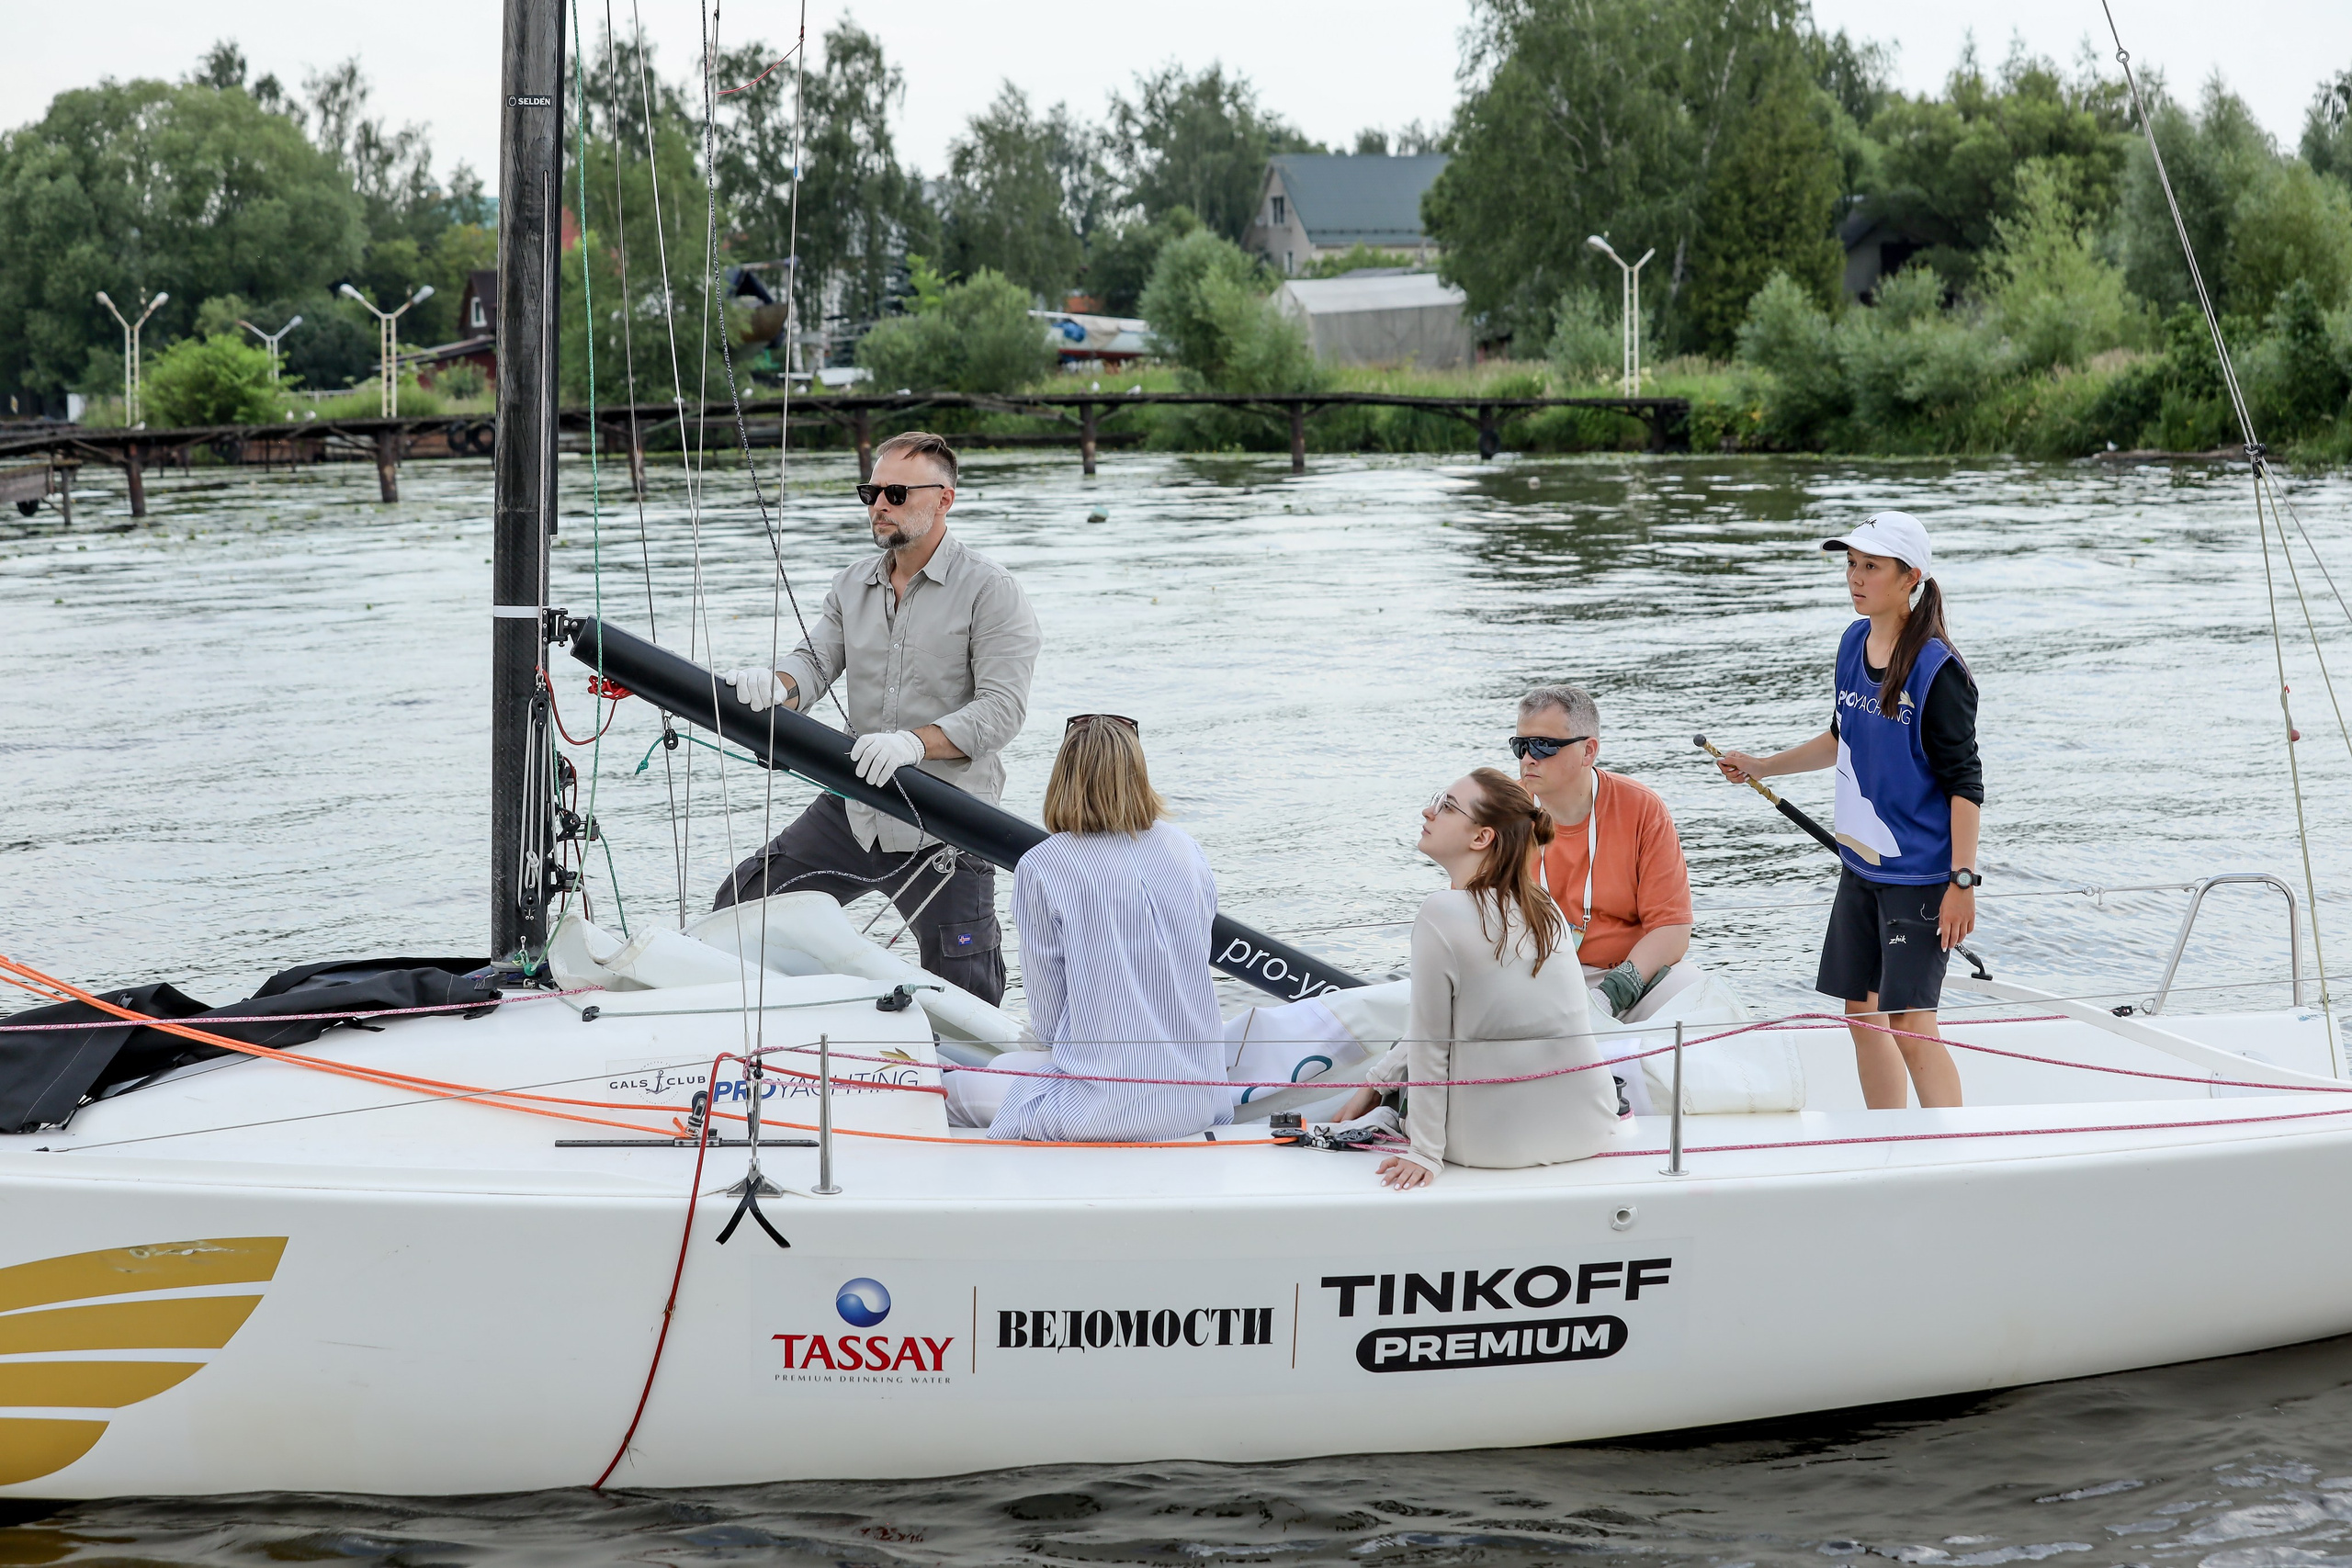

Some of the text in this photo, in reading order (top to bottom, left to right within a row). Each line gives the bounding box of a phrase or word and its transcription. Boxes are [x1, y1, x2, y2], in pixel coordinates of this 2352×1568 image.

[1889, 934, 1907, 945] zhik
[609, 1076, 707, 1089] GALS CLUB
[1320, 1258, 1672, 1317] TINKOFF
[996, 1307, 1275, 1354] ВЕДОМОСТИ
[1374, 1323, 1611, 1365] PREMIUM
[771, 1334, 956, 1371] TASSAY
[775, 1374, 832, 1382] PREMIUM
[839, 1375, 904, 1384] DRINKING
